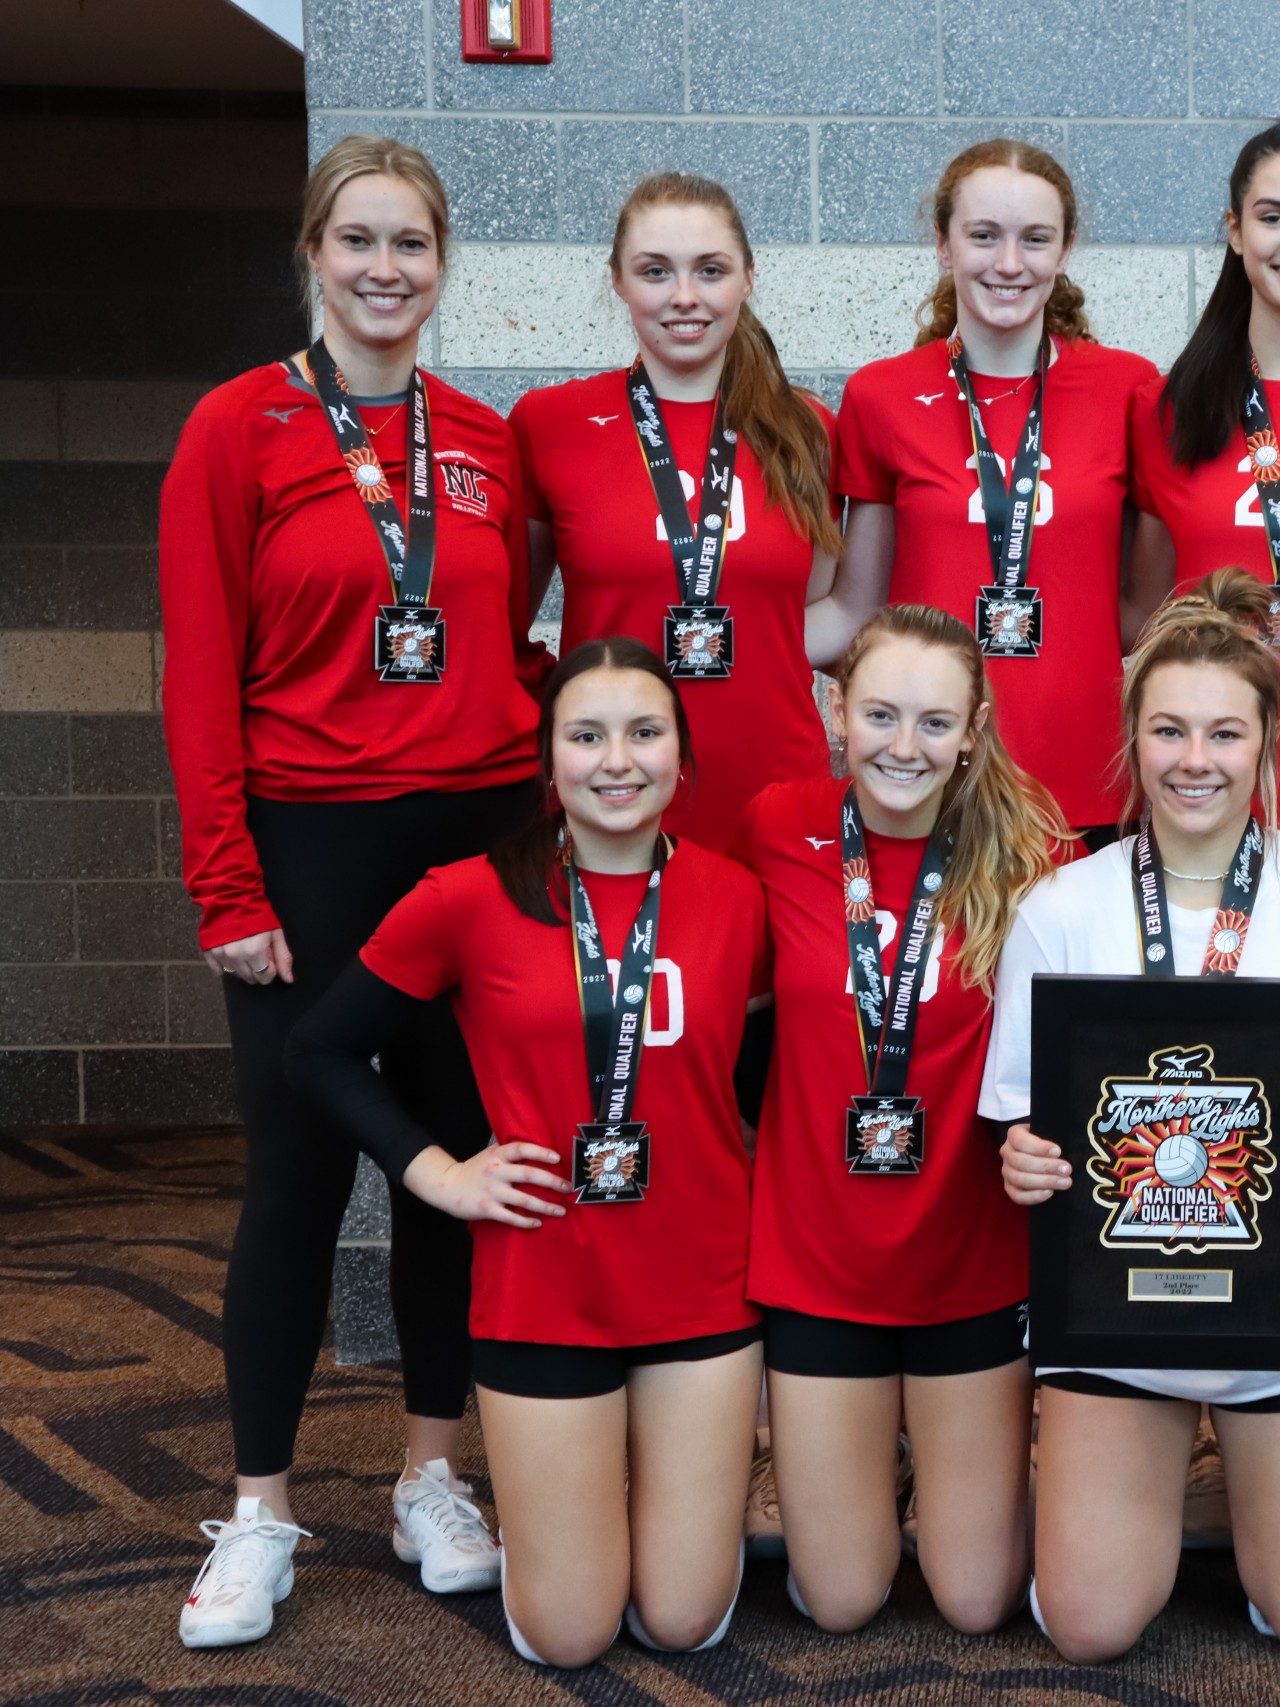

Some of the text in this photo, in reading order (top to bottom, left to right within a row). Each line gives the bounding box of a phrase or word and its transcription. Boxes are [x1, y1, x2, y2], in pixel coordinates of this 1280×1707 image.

[414, 390, 428, 498] NATIONAL QUALIFIER
[650, 457, 670, 468] 2022
[410, 507, 431, 518] 2022
[1008, 500, 1028, 559] QUALIFIER
[695, 536, 718, 596] QUALIFIER
[1234, 832, 1252, 893] Northern
[1140, 872, 1162, 936] QUALIFIER
[576, 921, 600, 959] Lights
[583, 974, 605, 983] 2022
[856, 944, 884, 1027] Northern Lights
[892, 899, 933, 1031] NATIONAL QUALIFIER
[614, 1013, 638, 1080] QUALIFIER
[884, 1045, 906, 1054] 2022
[857, 1114, 913, 1130] Northern Lights
[1098, 1095, 1260, 1141] Northern Lights
[1141, 1205, 1218, 1223] QUALIFIER
[1143, 1187, 1216, 1205] NATIONAL
